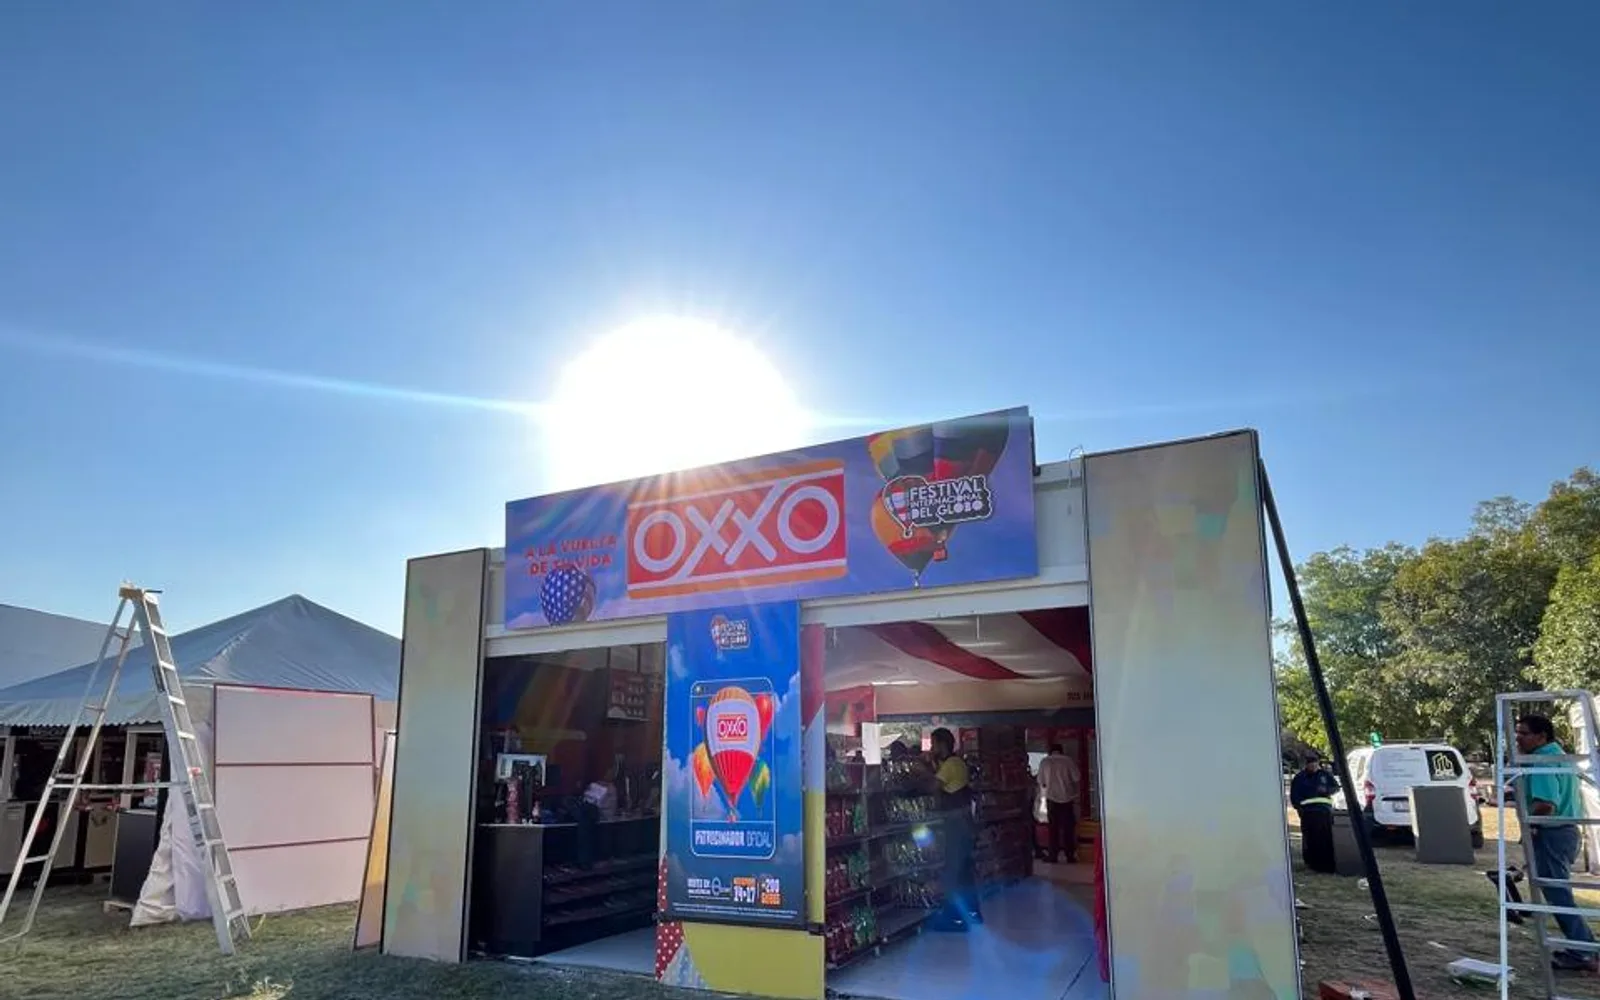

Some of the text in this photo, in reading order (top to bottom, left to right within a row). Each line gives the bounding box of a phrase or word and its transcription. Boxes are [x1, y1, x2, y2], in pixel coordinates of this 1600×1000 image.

[910, 479, 982, 501] FESTIVAL
[910, 493, 983, 508] INTERNACIONAL
[911, 500, 983, 519] DEL GLOBO
[633, 481, 840, 581] OXXO
[529, 561, 549, 576] DE
[717, 718, 747, 738] OXXO
